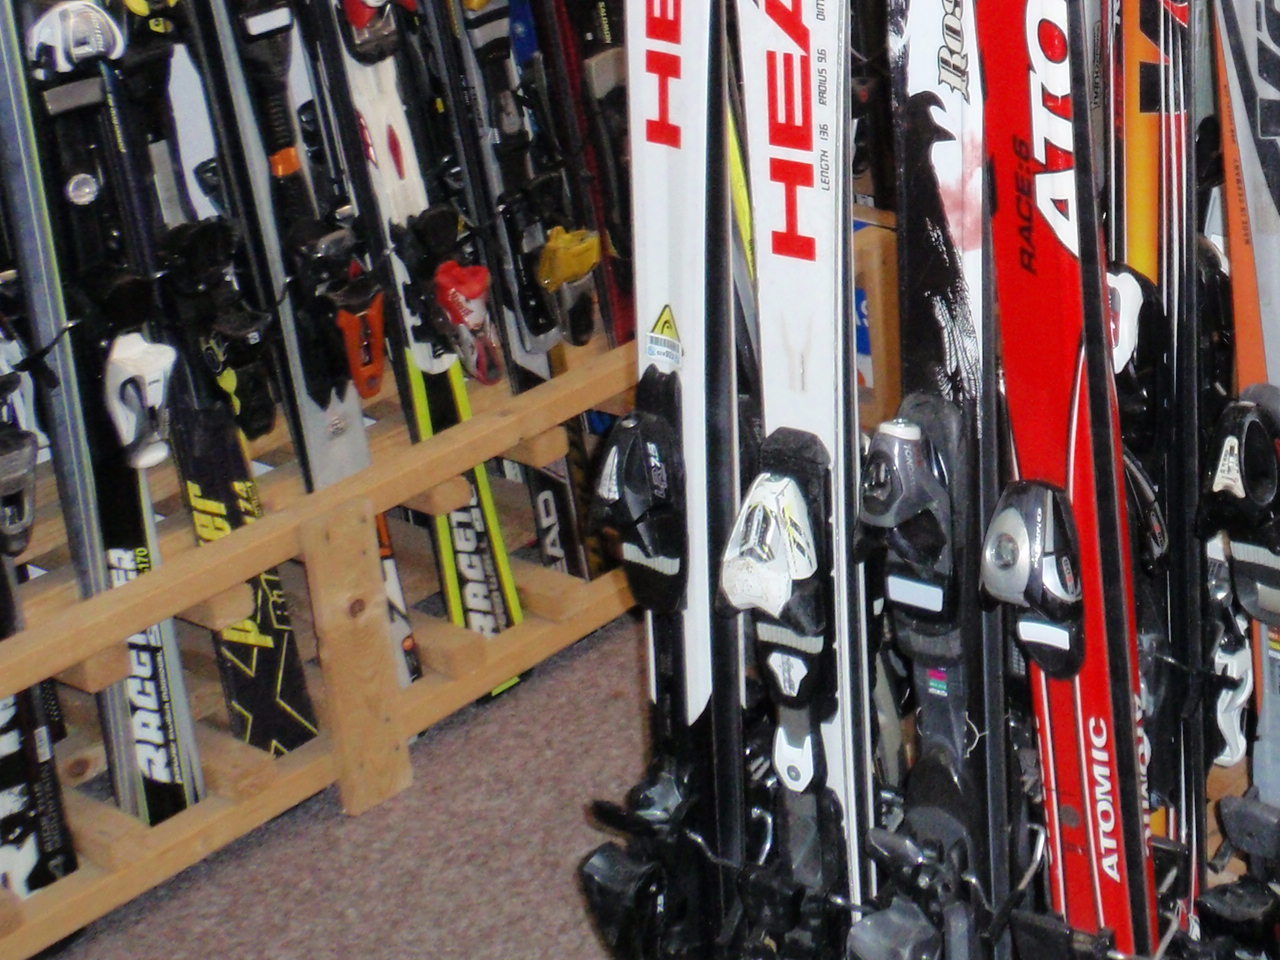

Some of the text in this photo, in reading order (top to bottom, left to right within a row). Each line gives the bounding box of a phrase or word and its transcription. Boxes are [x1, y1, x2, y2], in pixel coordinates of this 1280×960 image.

[815, 47, 831, 191] LENGTH 136 RADIUS 9.6
[1087, 716, 1120, 883] ATOMIC
